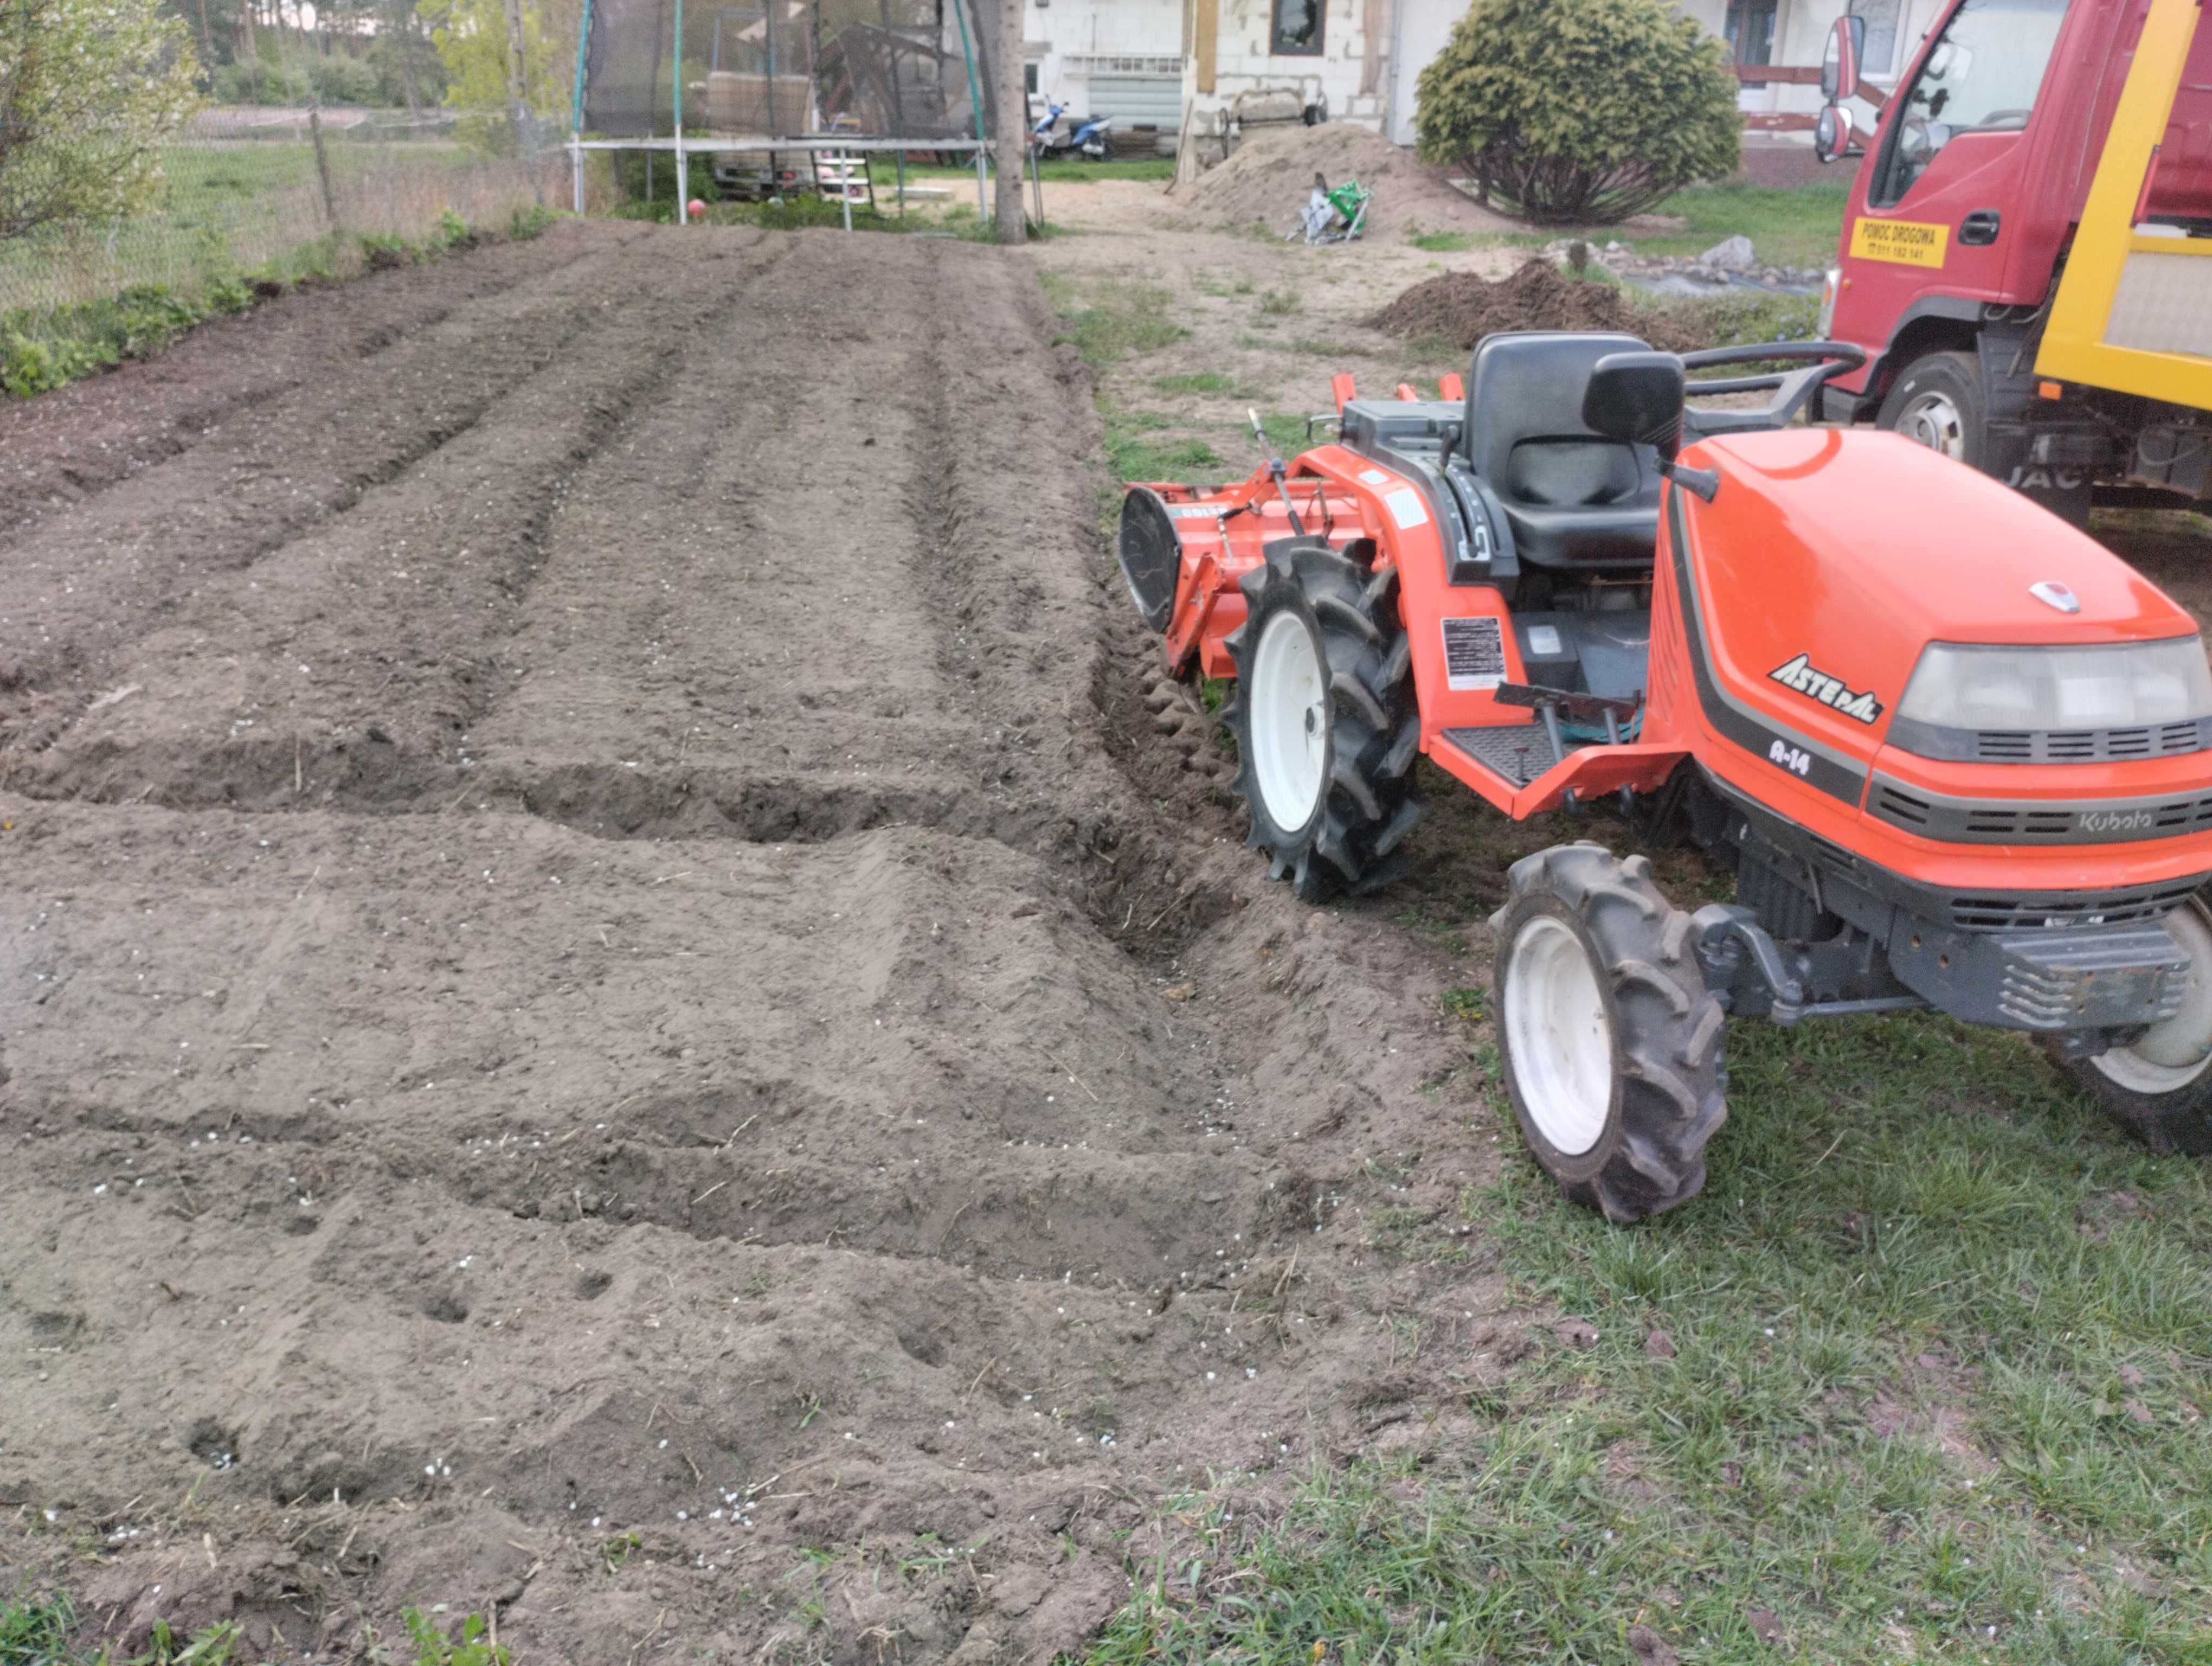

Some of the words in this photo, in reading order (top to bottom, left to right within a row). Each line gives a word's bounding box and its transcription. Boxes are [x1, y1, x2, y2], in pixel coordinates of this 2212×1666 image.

[1862, 223, 1891, 240] POMOC
[1892, 226, 1935, 245] DROGOWA
[2003, 466, 2081, 489] JAC
[1769, 740, 1810, 776] A-14
[2079, 810, 2152, 832] Kubota
